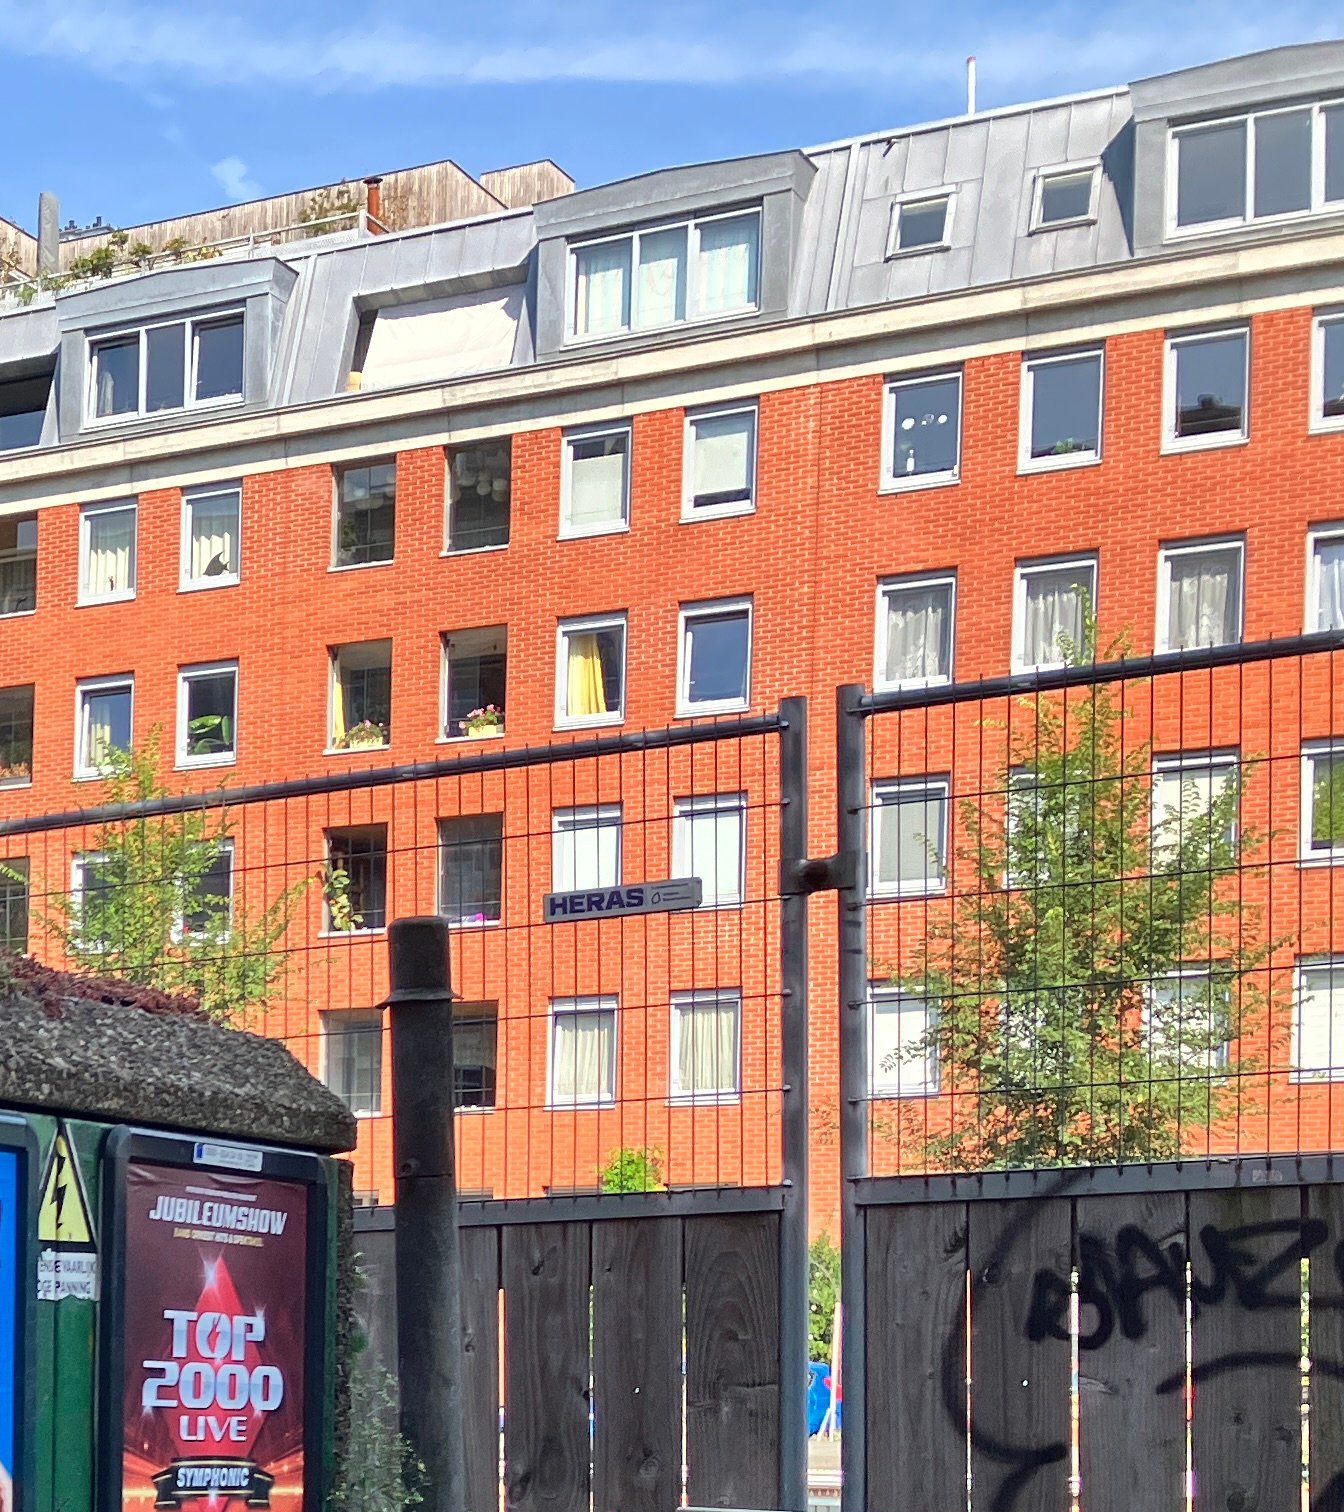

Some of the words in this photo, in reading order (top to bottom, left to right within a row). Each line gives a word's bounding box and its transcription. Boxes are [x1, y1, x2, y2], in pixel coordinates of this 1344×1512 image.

[549, 888, 644, 916] HERAS
[148, 1195, 288, 1235] JUBILEUMSHOW
[163, 1309, 266, 1361] TOP
[142, 1360, 284, 1411] 2000
[179, 1415, 247, 1442] LIVE
[176, 1467, 250, 1488] SYMPHONIC
